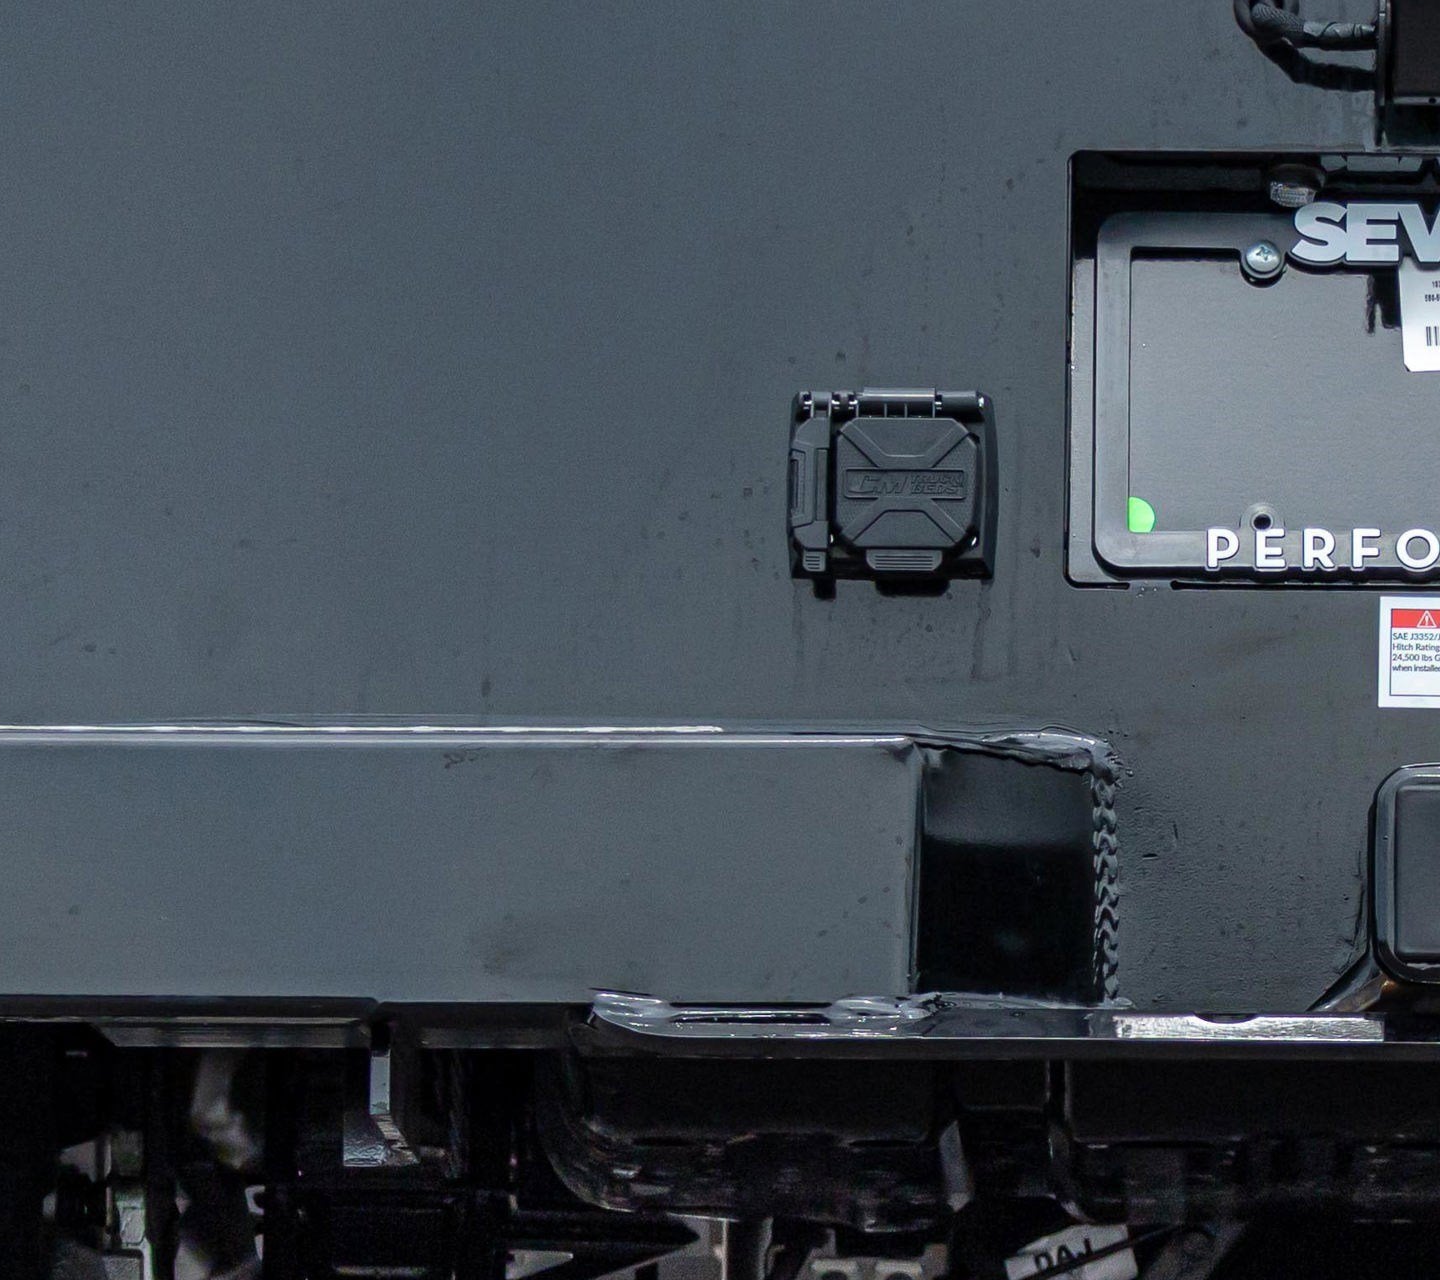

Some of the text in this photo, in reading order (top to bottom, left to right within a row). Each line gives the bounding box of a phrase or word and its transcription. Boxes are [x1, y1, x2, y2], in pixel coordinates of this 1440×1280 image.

[1392, 632, 1408, 641] SAE
[1392, 643, 1413, 651] Hitch
[1392, 653, 1420, 662] 24,500
[1421, 654, 1432, 662] lbs
[1392, 664, 1412, 672] when
